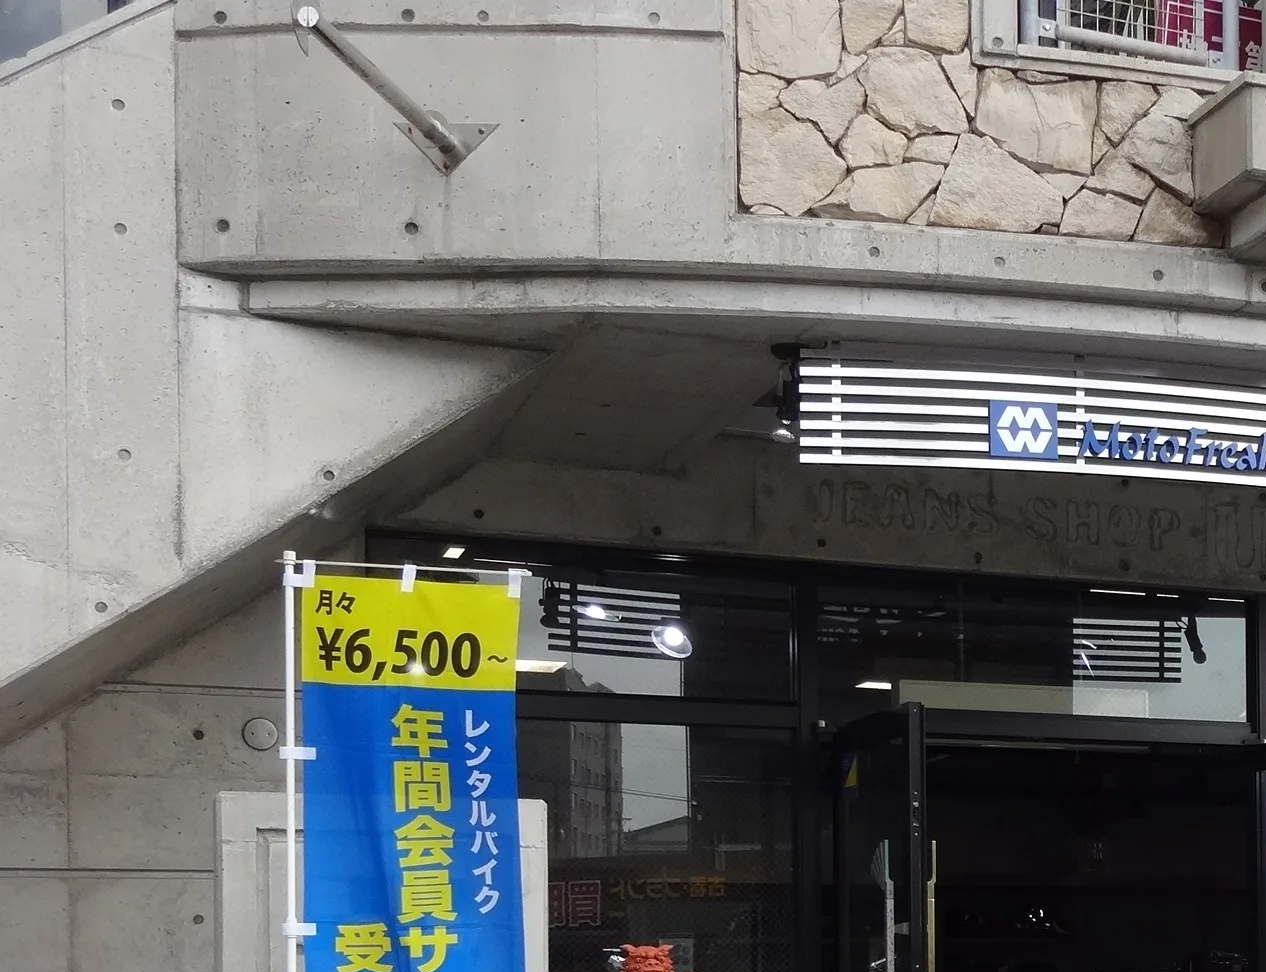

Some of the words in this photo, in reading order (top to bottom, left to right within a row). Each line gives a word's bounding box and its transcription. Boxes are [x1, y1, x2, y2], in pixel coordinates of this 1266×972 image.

[314, 589, 356, 615] 月々
[463, 709, 500, 915] レンタルバイク
